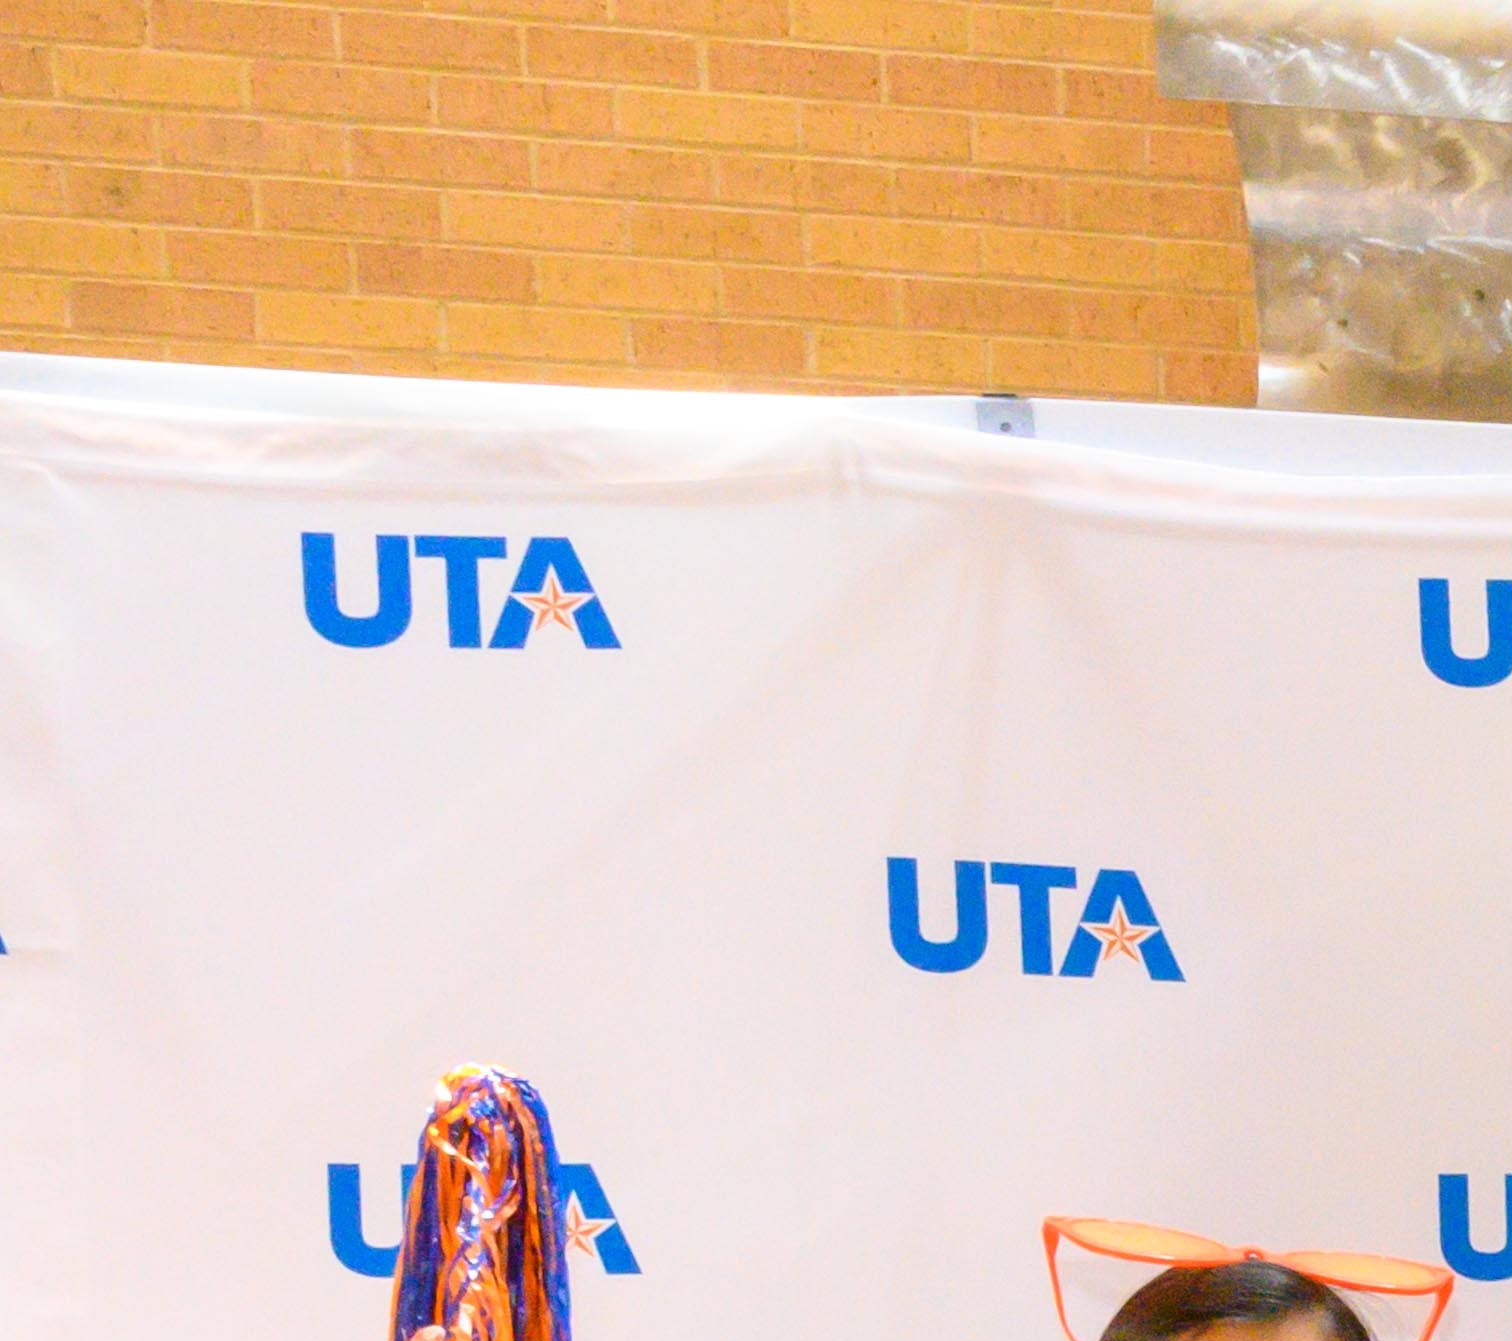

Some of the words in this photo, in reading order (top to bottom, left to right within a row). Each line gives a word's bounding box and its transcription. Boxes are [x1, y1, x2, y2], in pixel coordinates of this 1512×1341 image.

[301, 531, 621, 650] UTA
[887, 857, 1187, 983] UTA
[327, 1163, 643, 1278] UA
